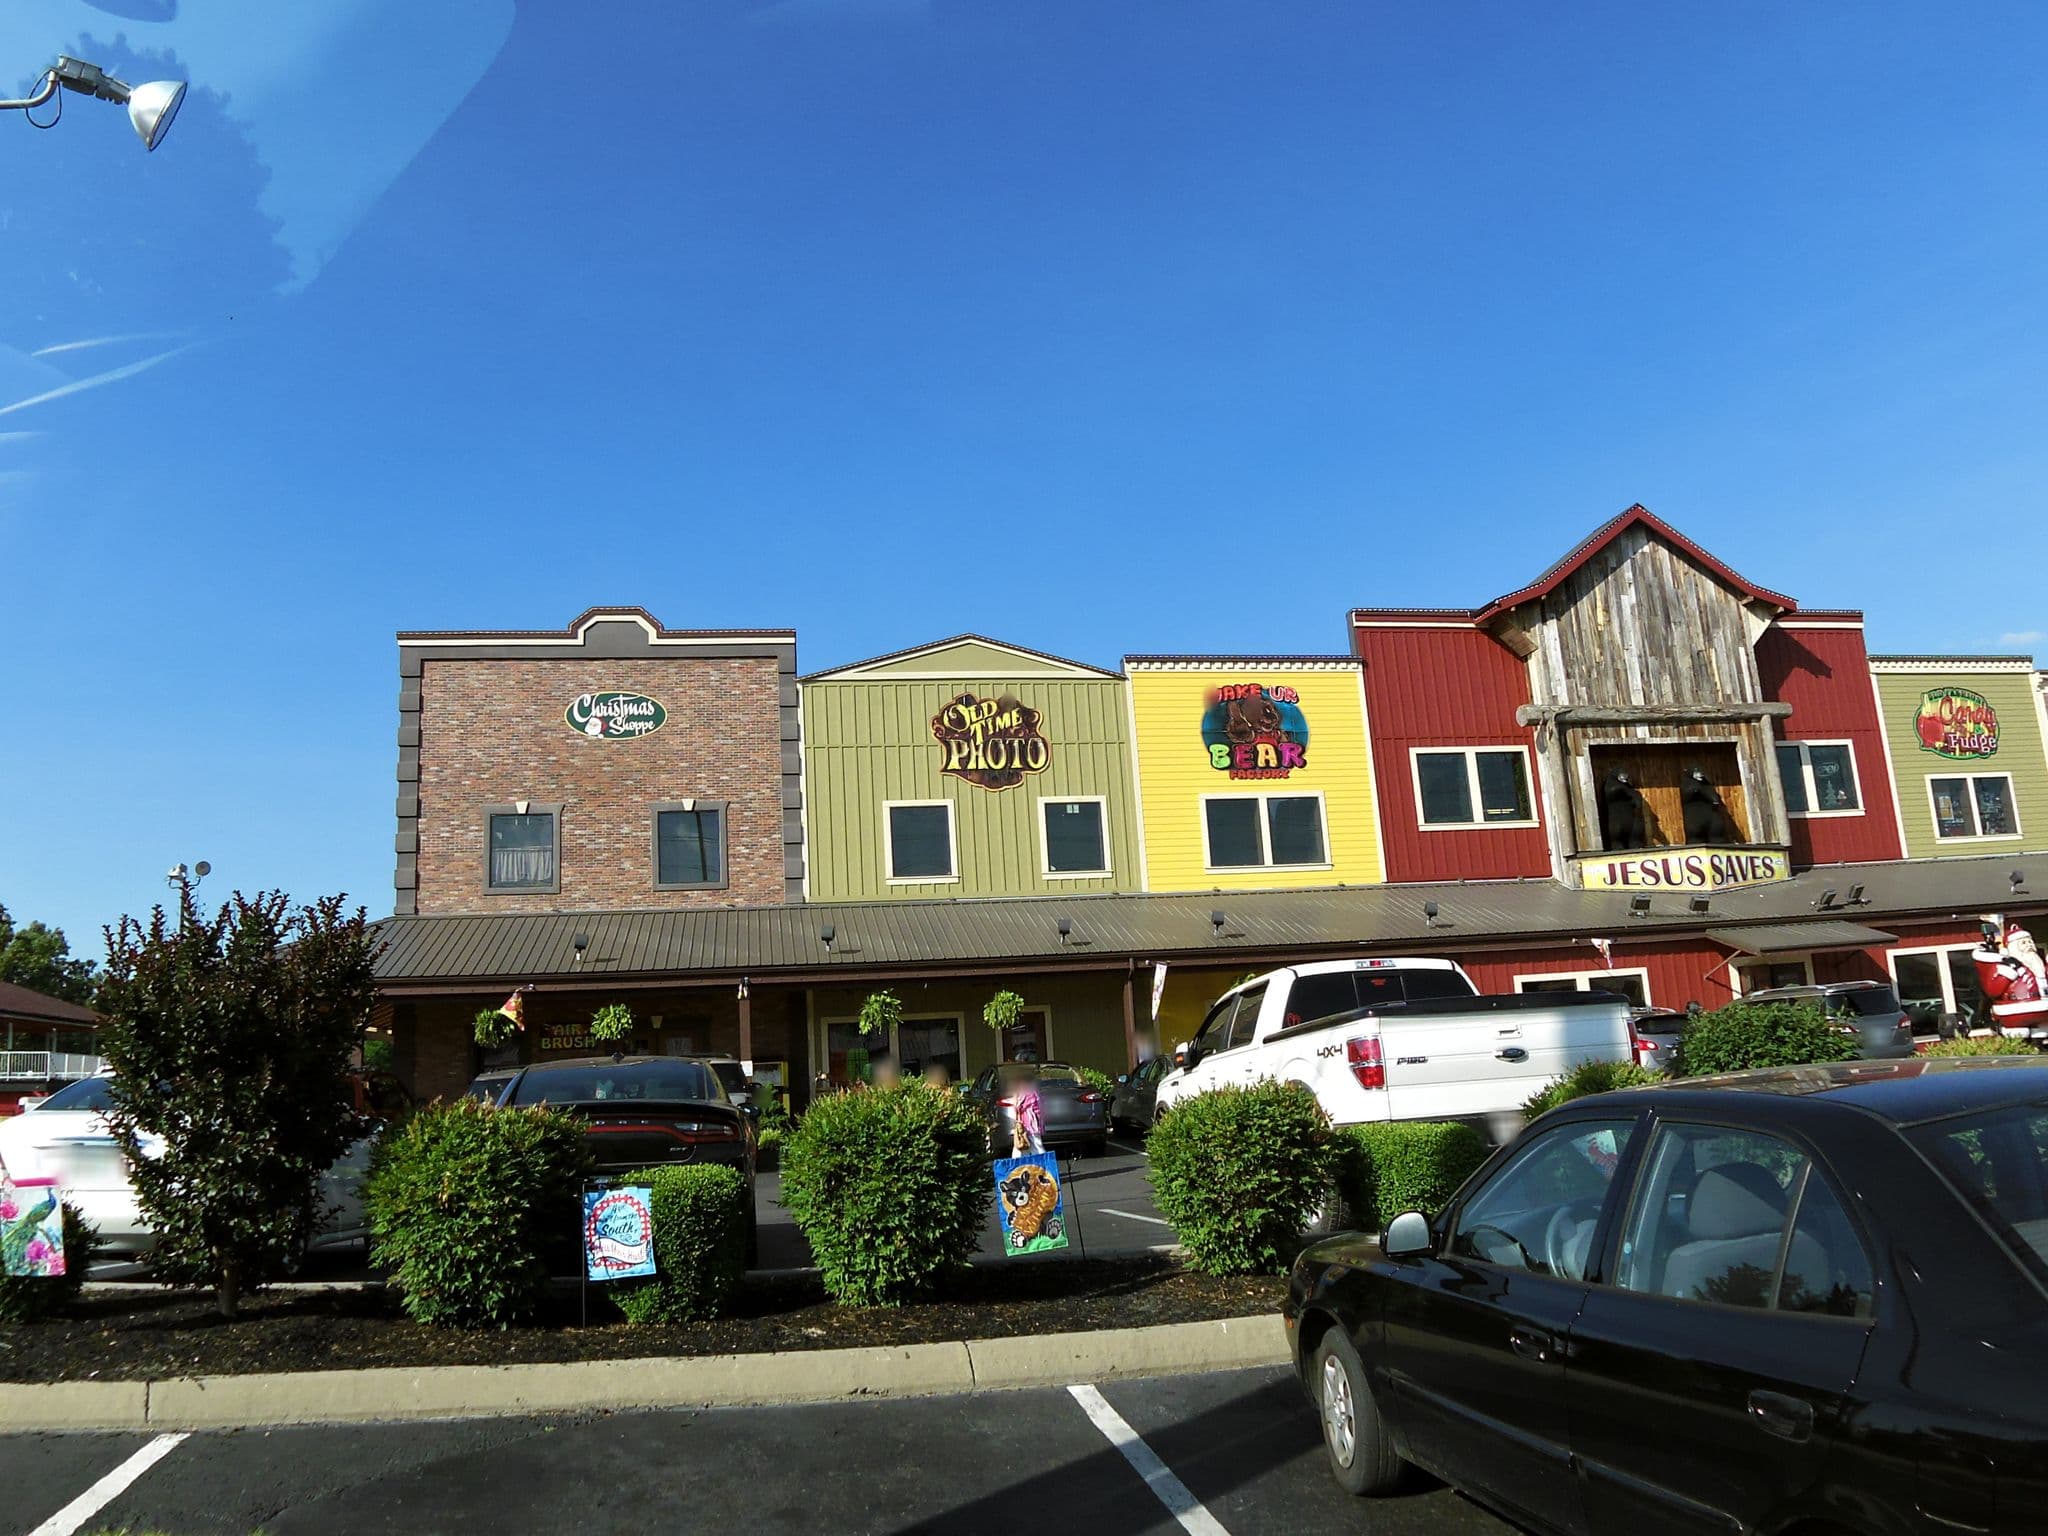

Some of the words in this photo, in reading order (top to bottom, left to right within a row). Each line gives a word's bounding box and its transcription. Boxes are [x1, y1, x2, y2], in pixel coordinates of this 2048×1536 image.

[573, 693, 655, 722] Christmas
[943, 700, 998, 732] OLD
[609, 717, 655, 735] Shoppe
[970, 708, 1023, 745] TIME
[945, 738, 1047, 770] PHOTO
[1209, 743, 1307, 769] BEAR
[1948, 734, 1997, 753] Fudge
[1229, 769, 1290, 780] FACTORY
[1603, 856, 1706, 887] JESUS
[1710, 854, 1775, 886] SAVES
[541, 1036, 596, 1049] BRUSH
